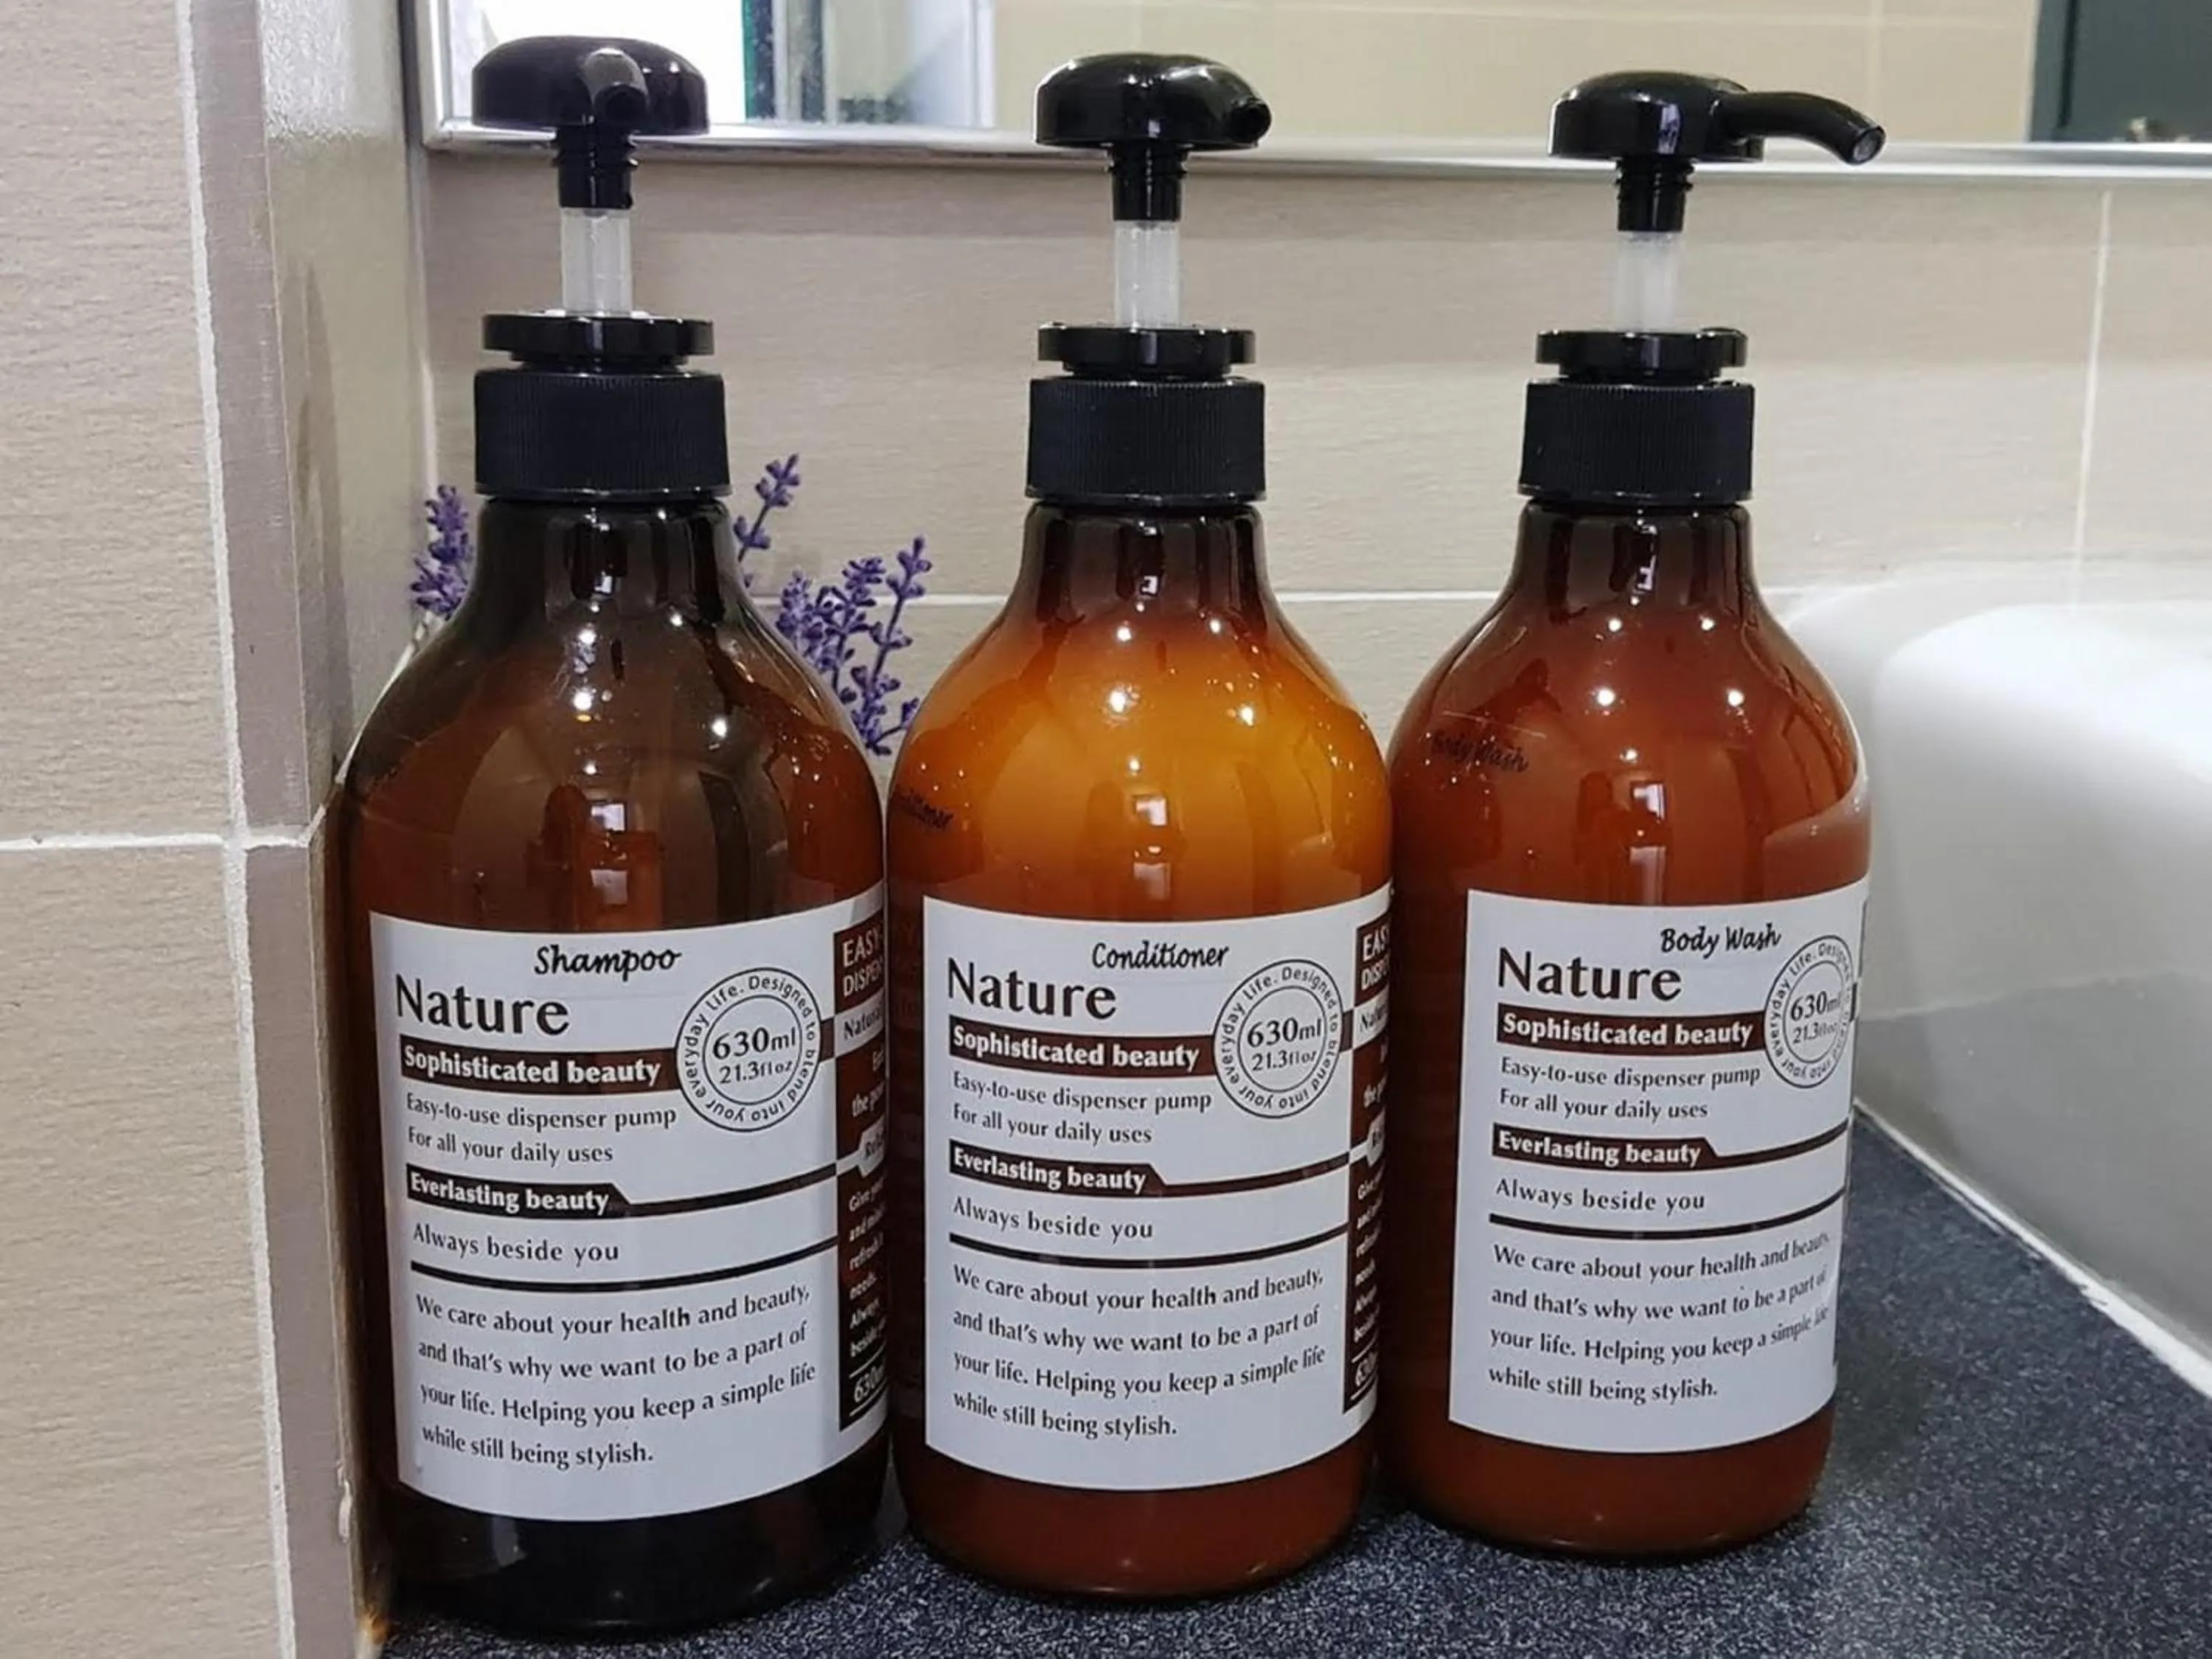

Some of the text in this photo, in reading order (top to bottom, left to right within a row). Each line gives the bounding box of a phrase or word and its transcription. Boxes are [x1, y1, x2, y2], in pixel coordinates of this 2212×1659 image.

[1092, 940, 1229, 970] Conditioner
[1660, 922, 1782, 959] Body Wash
[534, 944, 682, 982] Shampoo
[1498, 947, 1681, 1001] Nature
[395, 973, 569, 1036] Nature
[748, 975, 812, 1018] Designed
[948, 958, 1116, 1020] Nature
[712, 1026, 796, 1060] 630ml
[806, 1021, 815, 1041] to
[954, 1025, 1200, 1072] Sophisticated beauty
[1248, 1018, 1322, 1048] 630ml
[1503, 1012, 1753, 1048] Sophisticated beauty
[405, 1045, 661, 1086] Sophisticated beauty
[684, 1014, 709, 1098] everyday
[787, 1049, 815, 1102] blend
[1501, 1056, 1760, 1092] Easy-to-use dispenser pump
[406, 1091, 676, 1133] Easy-to-use dispenser pump
[706, 1099, 745, 1122] your
[751, 1099, 785, 1121] into
[953, 1070, 1211, 1116] Easy-to-use dispenser pump
[1500, 1088, 1708, 1123] For all your daily uses
[953, 1102, 1152, 1147] For all your daily uses
[408, 1125, 613, 1168] For all your daily uses
[1499, 1130, 1701, 1167] Everlasting beauty
[954, 1147, 1146, 1194] Everlasting beauty
[411, 1172, 609, 1216] Everlasting beauty
[1496, 1178, 1705, 1216] Always beside you
[953, 1196, 1152, 1245] Always beside you
[413, 1222, 619, 1267] Always beside you
[1494, 1242, 1790, 1284] We care about your health and
[953, 1264, 980, 1289] We
[984, 1279, 1024, 1299] care
[1030, 1283, 1088, 1307] about
[1096, 1295, 1145, 1314] your
[1152, 1285, 1217, 1309] health
[1222, 1279, 1259, 1304] and
[1492, 1288, 1786, 1324] and that's why we want to be a
[416, 1293, 442, 1319] We
[448, 1308, 487, 1328] care
[493, 1310, 554, 1334] about
[561, 1320, 613, 1340] your
[620, 1307, 691, 1332] health
[698, 1297, 737, 1324] and
[953, 1304, 1320, 1354] and that's why we want to be a part of
[418, 1321, 807, 1383] and that's why we want to be a part of
[1491, 1329, 1767, 1365] your life. Helping you keep a
[953, 1345, 1325, 1399] your life. Helping you keep a simple life
[1489, 1366, 1717, 1406] while still being stylish.
[420, 1362, 815, 1427] your life. Helping you keep a simple life
[953, 1391, 1177, 1441] while still being stylish.
[422, 1425, 653, 1470] while still being stylish.
